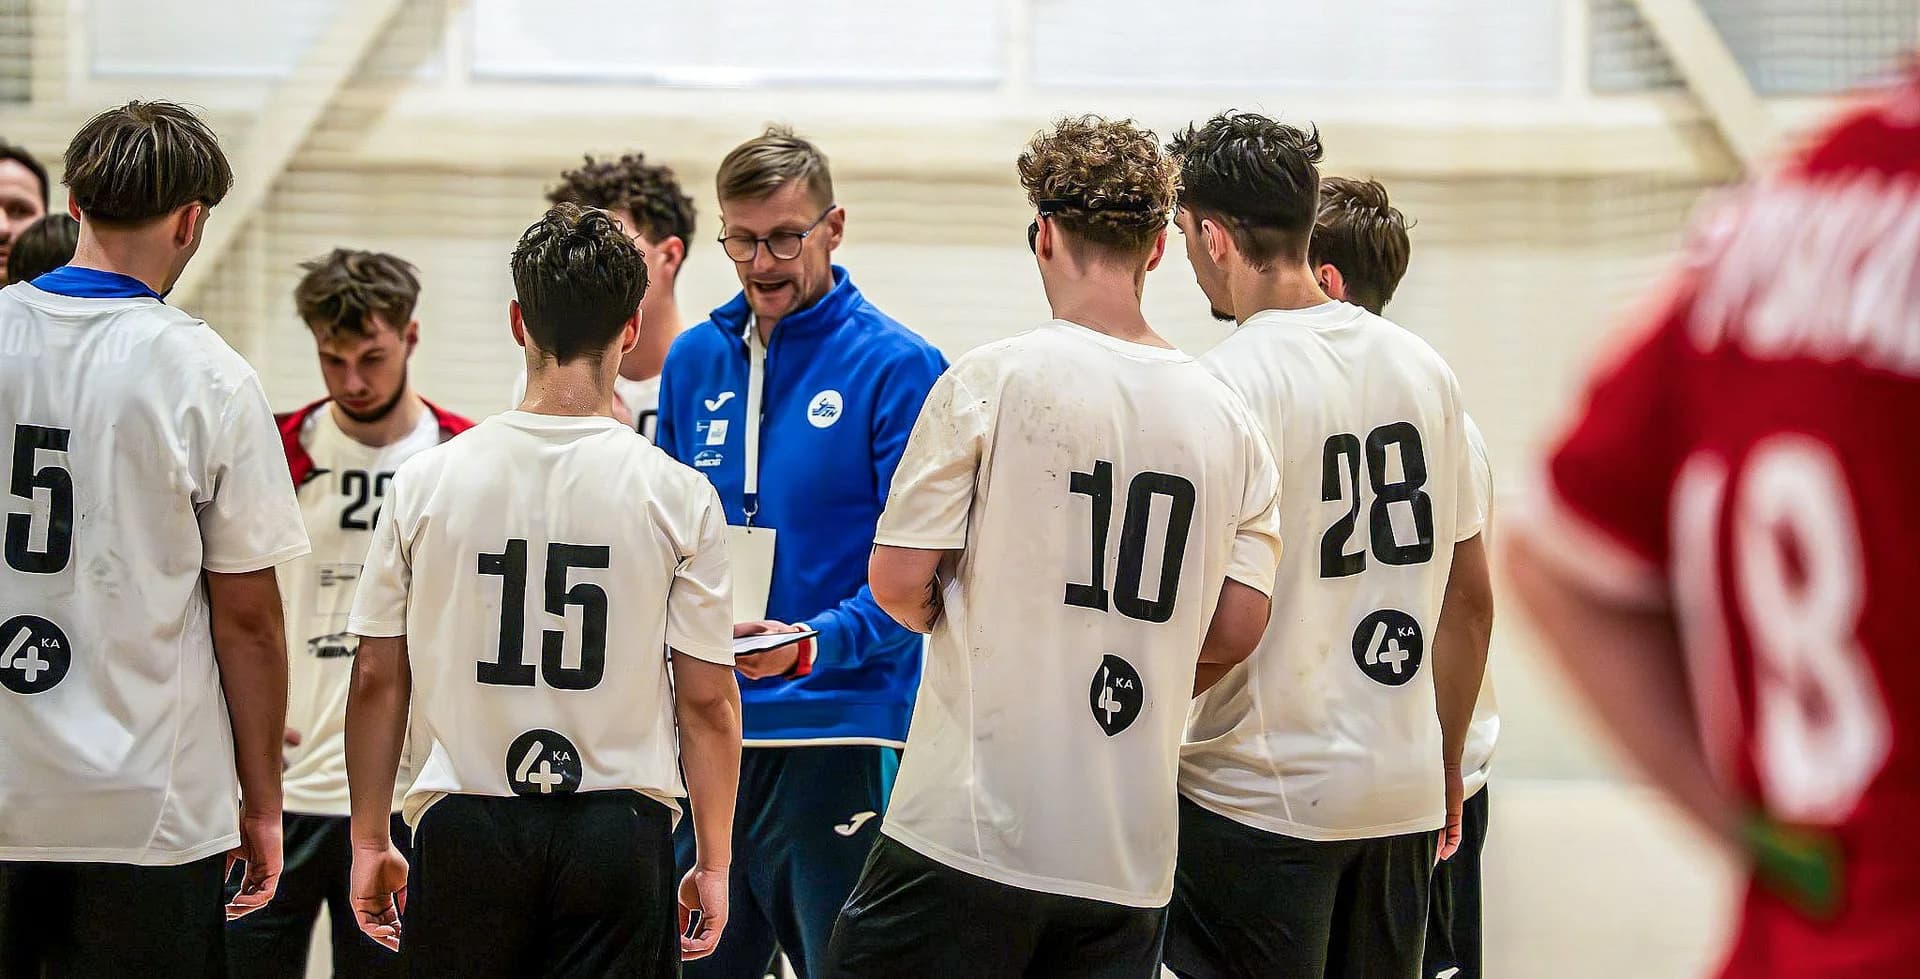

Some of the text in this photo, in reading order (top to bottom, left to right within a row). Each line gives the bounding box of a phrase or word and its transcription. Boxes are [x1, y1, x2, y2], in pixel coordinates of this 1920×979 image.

[4, 423, 74, 575] 5
[1064, 459, 1196, 624] 10
[1319, 421, 1434, 578] 28
[41, 637, 61, 649] KA
[476, 538, 611, 690] 15
[1115, 676, 1134, 691] KA
[1397, 626, 1416, 638] KA
[1668, 432, 1893, 825] 18
[552, 750, 571, 763] KA
